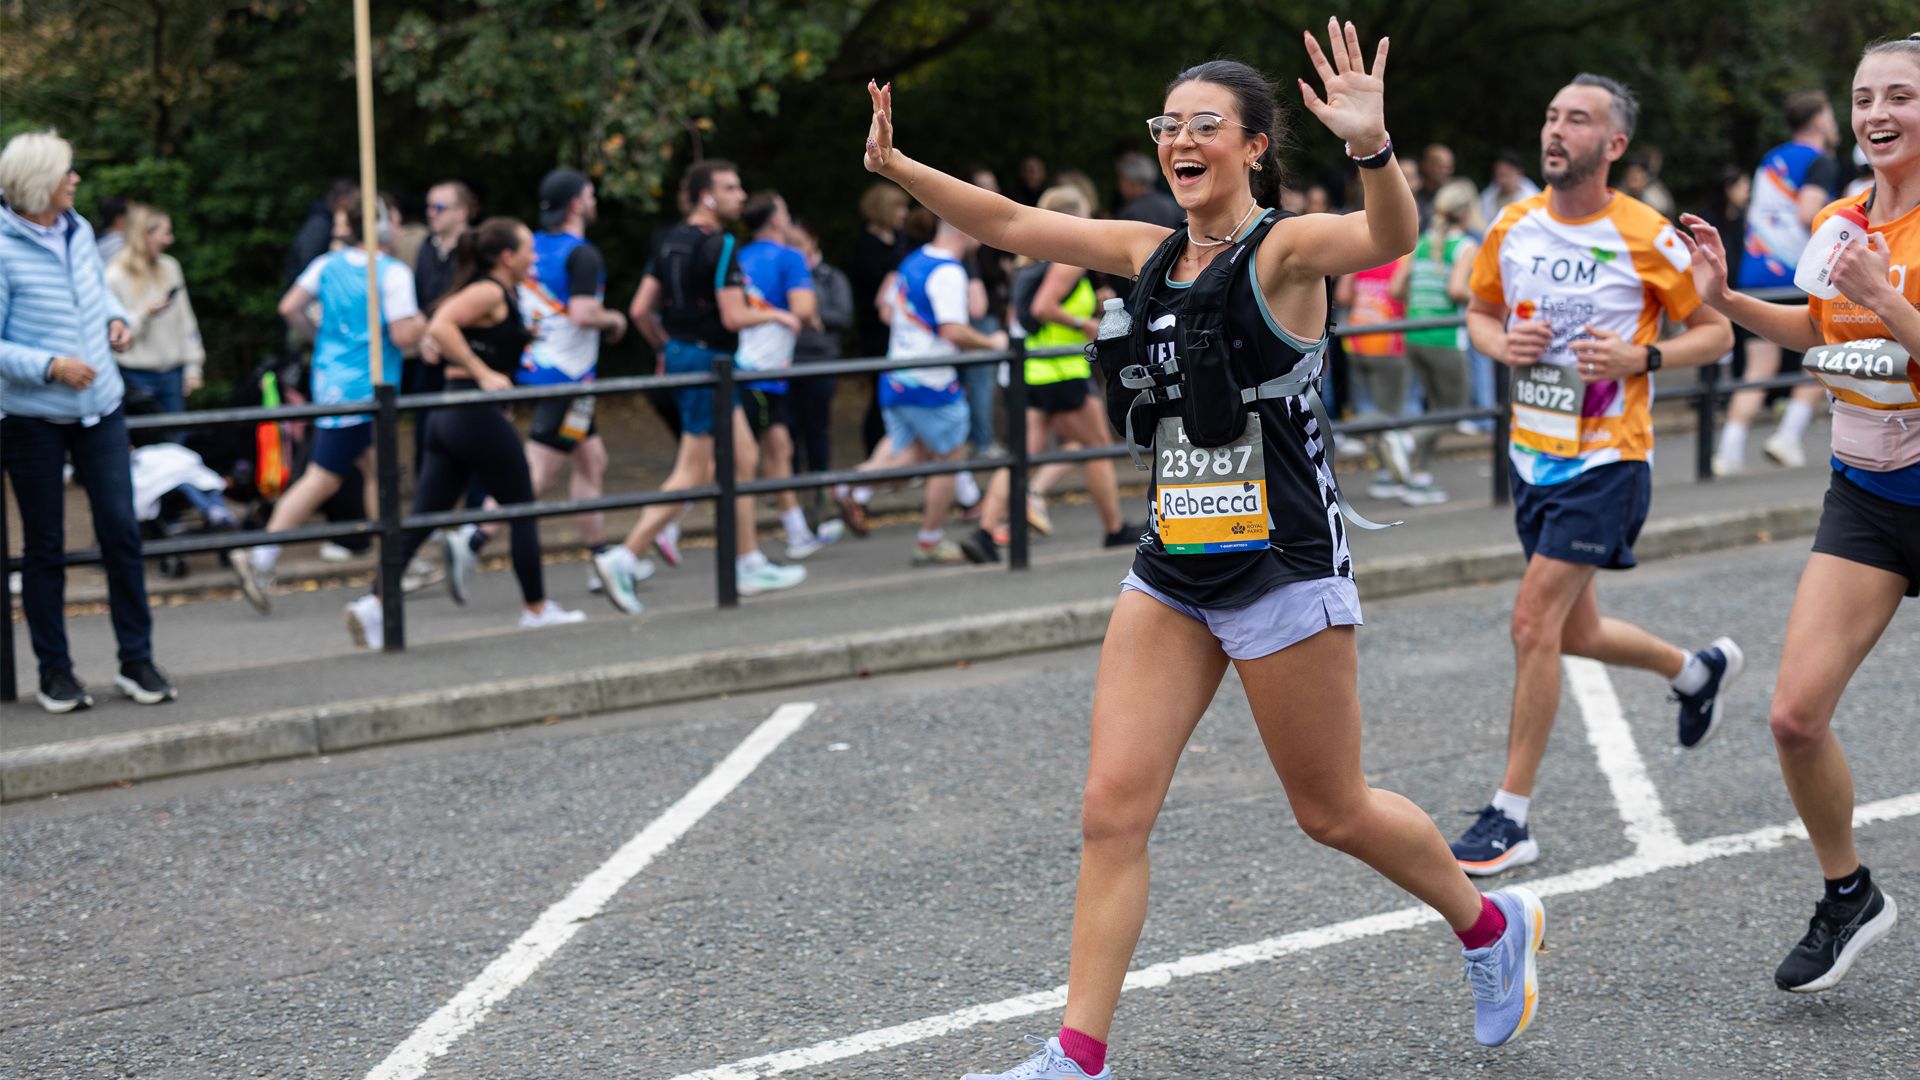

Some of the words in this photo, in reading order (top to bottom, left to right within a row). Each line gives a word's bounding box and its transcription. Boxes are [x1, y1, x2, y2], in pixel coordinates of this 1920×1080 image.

[1531, 256, 1598, 284] TOM
[1817, 350, 1894, 377] 14910
[1517, 380, 1576, 411] 18072
[1161, 445, 1252, 478] 23987
[1164, 489, 1258, 516] Rebecca
